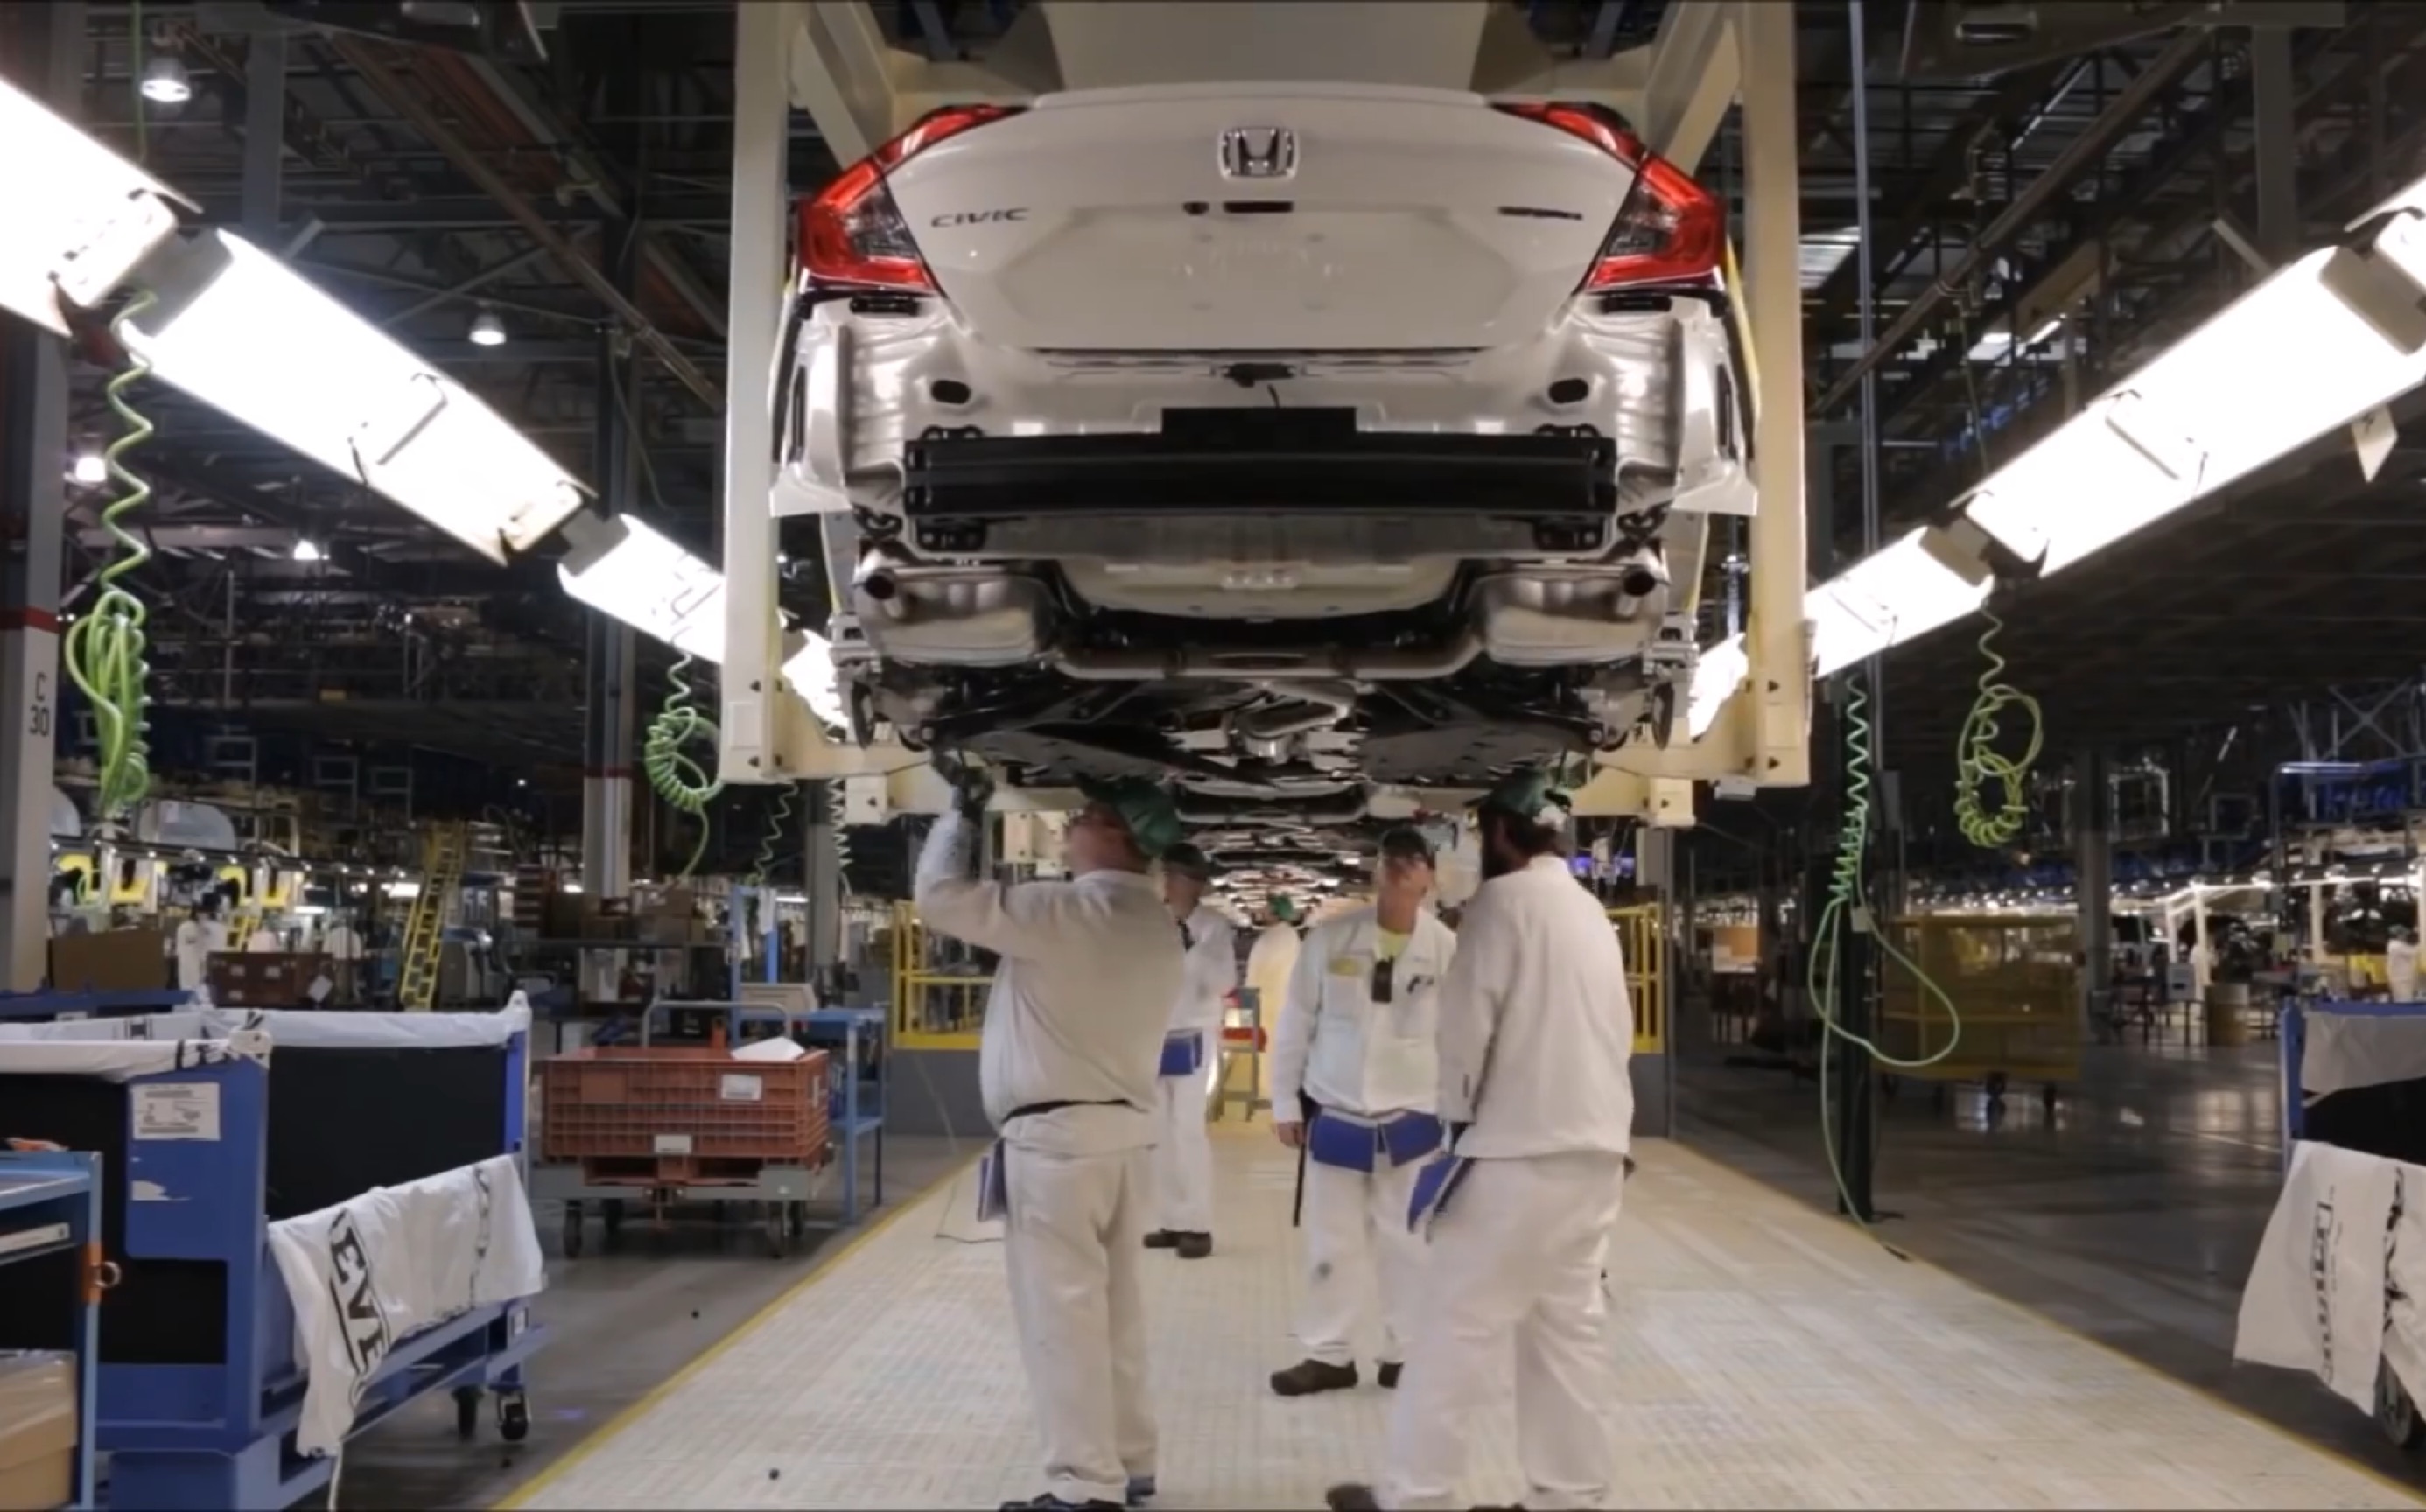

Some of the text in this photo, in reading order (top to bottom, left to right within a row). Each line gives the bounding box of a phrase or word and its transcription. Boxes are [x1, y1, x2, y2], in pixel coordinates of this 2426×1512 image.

[930, 207, 1031, 228] CIVIC
[35, 671, 47, 702] C
[29, 704, 50, 737] 30
